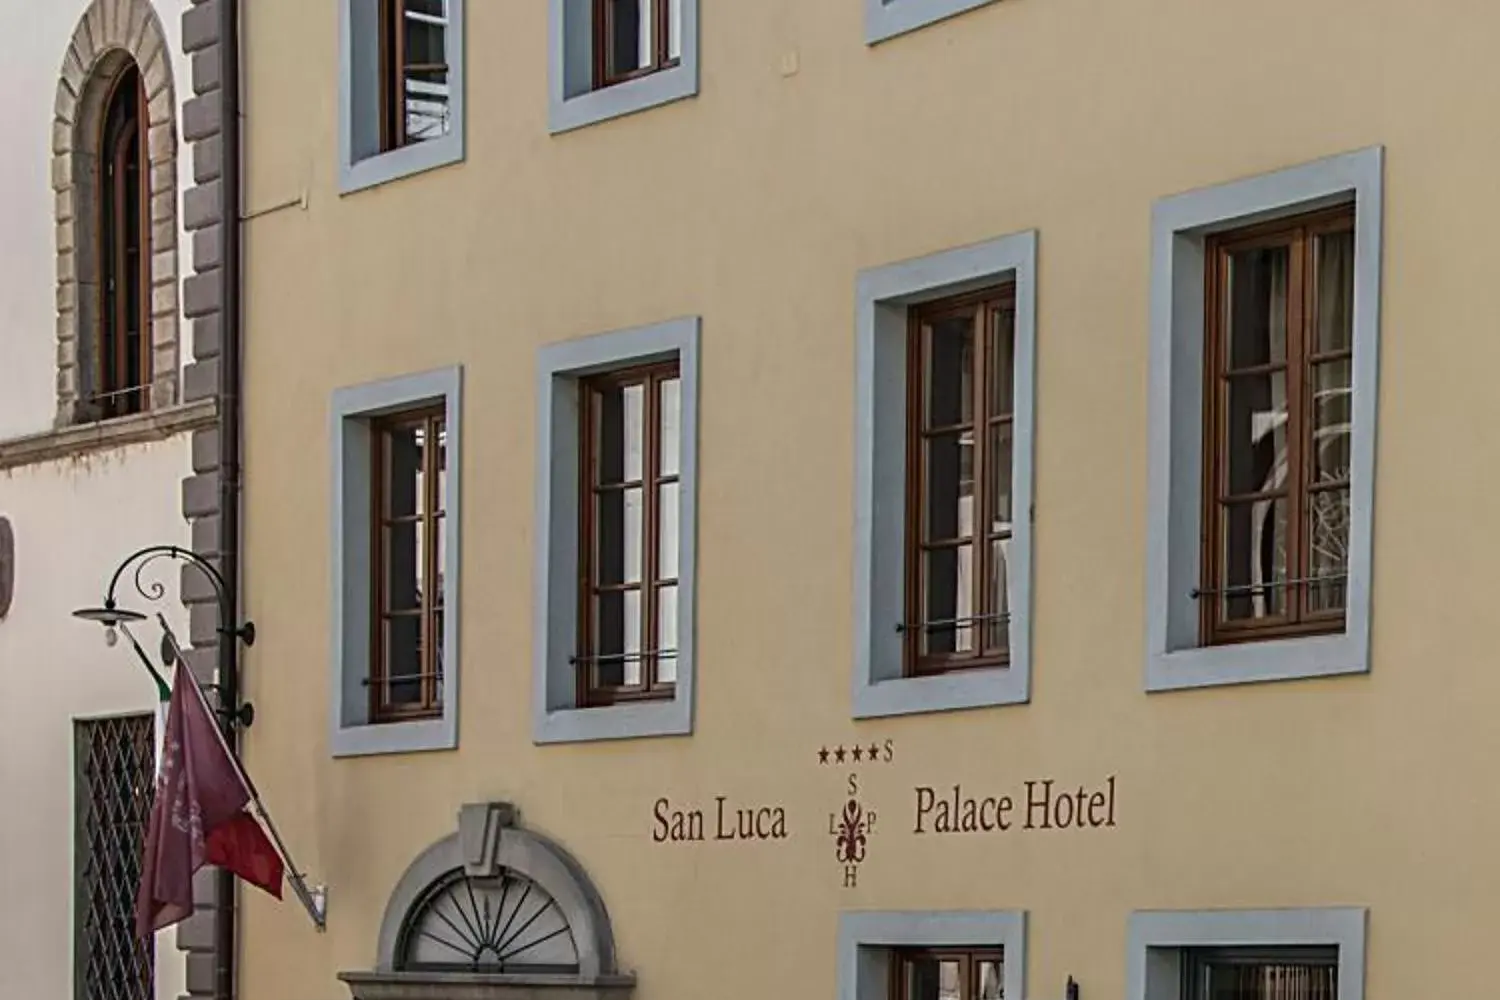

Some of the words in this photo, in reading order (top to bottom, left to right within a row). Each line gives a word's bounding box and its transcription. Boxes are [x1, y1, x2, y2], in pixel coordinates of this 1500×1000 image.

[847, 774, 858, 796] S
[652, 797, 705, 842] San
[713, 796, 788, 842] Luca
[913, 784, 1013, 834] Palace
[1023, 777, 1117, 830] Hotel
[842, 865, 858, 888] H
